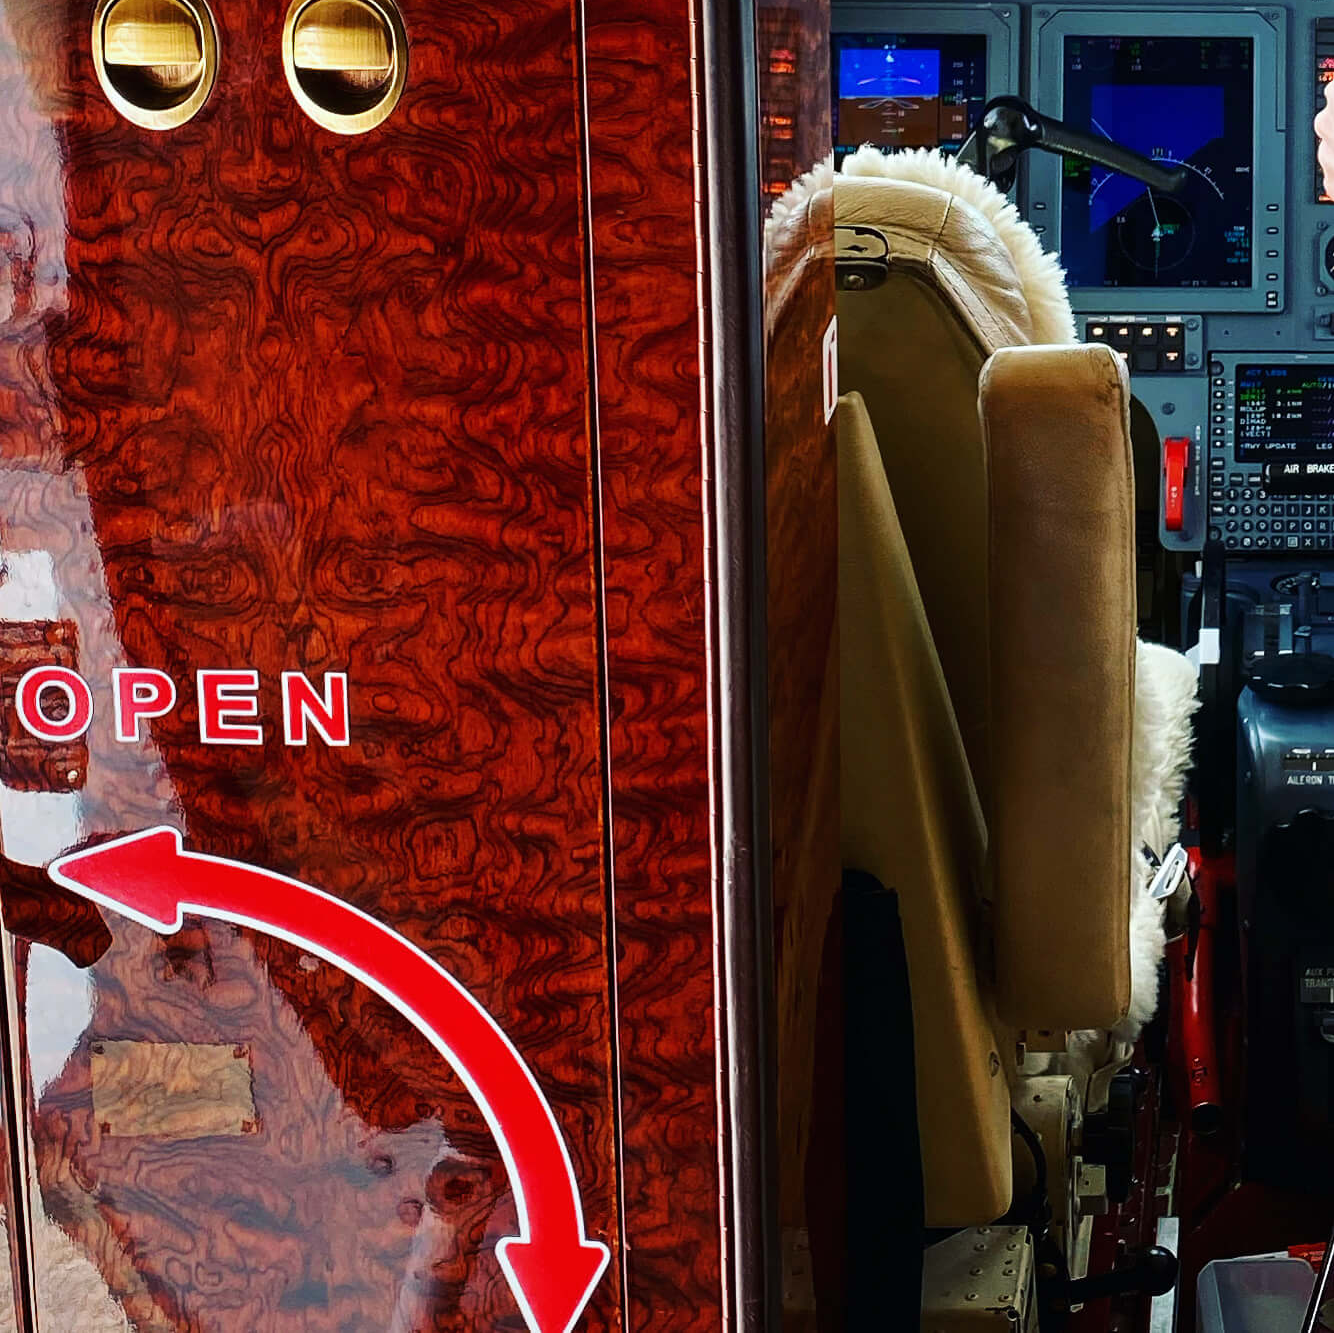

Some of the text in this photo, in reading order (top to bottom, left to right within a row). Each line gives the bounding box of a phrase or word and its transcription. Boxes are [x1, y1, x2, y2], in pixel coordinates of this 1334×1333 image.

[1283, 464, 1300, 473] AIR
[15, 665, 350, 747] OPEN
[1286, 776, 1323, 785] AILERON
[1306, 968, 1323, 976] AUX
